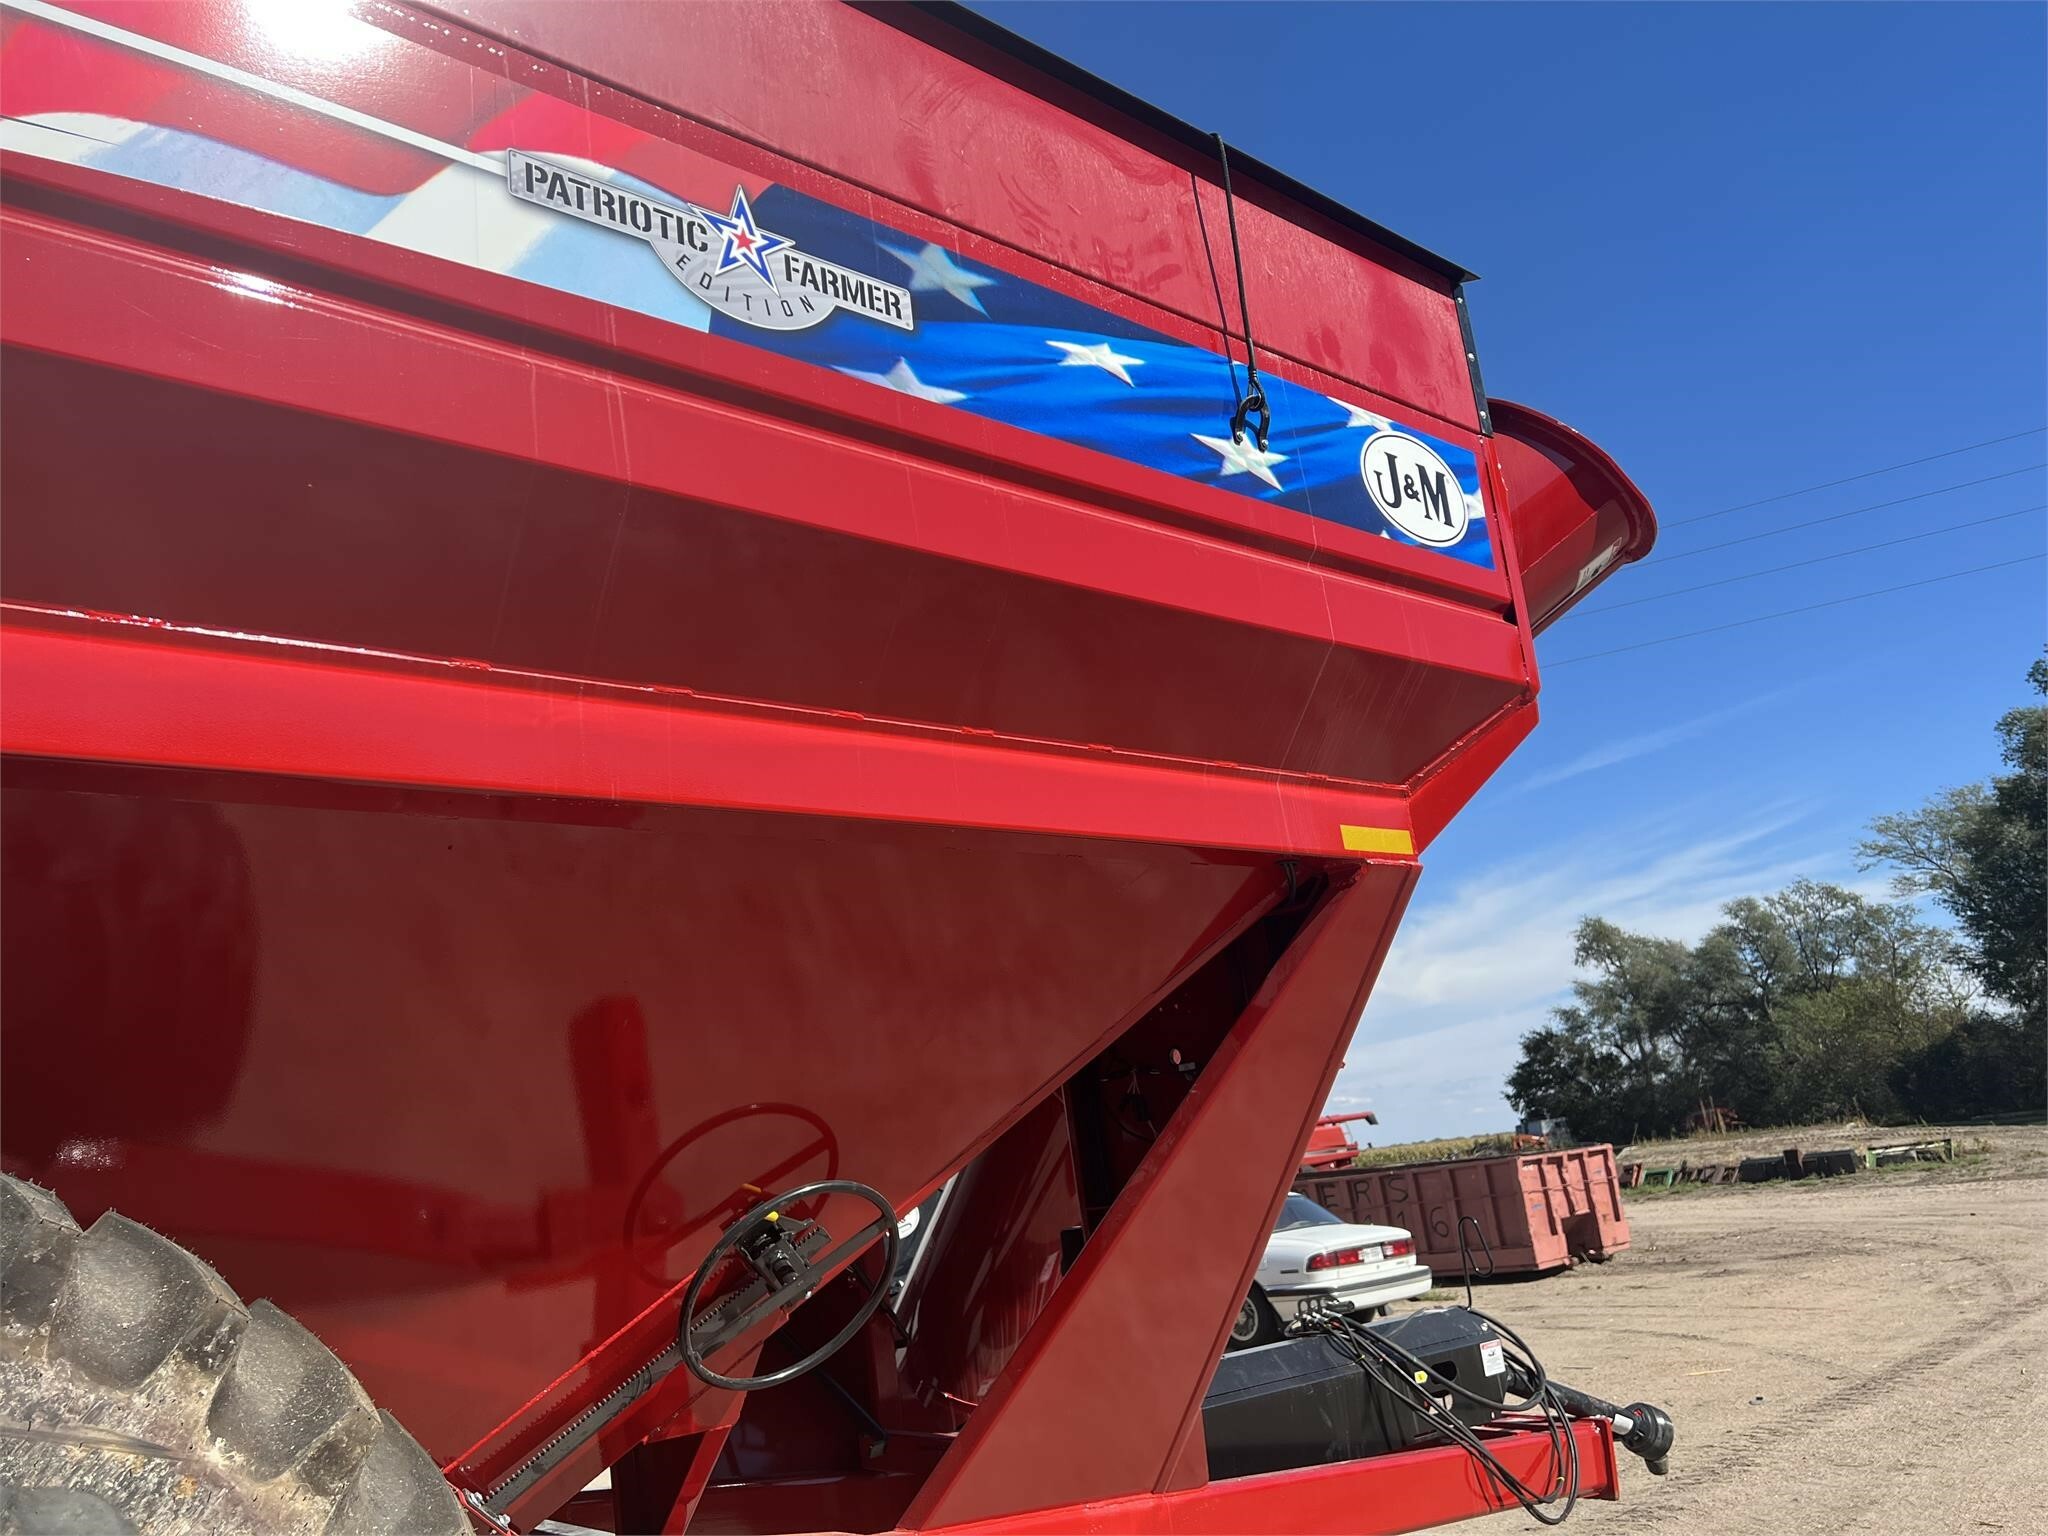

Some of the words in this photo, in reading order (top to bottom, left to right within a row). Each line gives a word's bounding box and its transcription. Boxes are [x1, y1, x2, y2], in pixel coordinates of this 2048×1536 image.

[524, 161, 709, 254] PATRIOTIC
[784, 253, 903, 321] FARMER
[675, 253, 815, 318] EDITION
[1373, 451, 1455, 528] J&M
